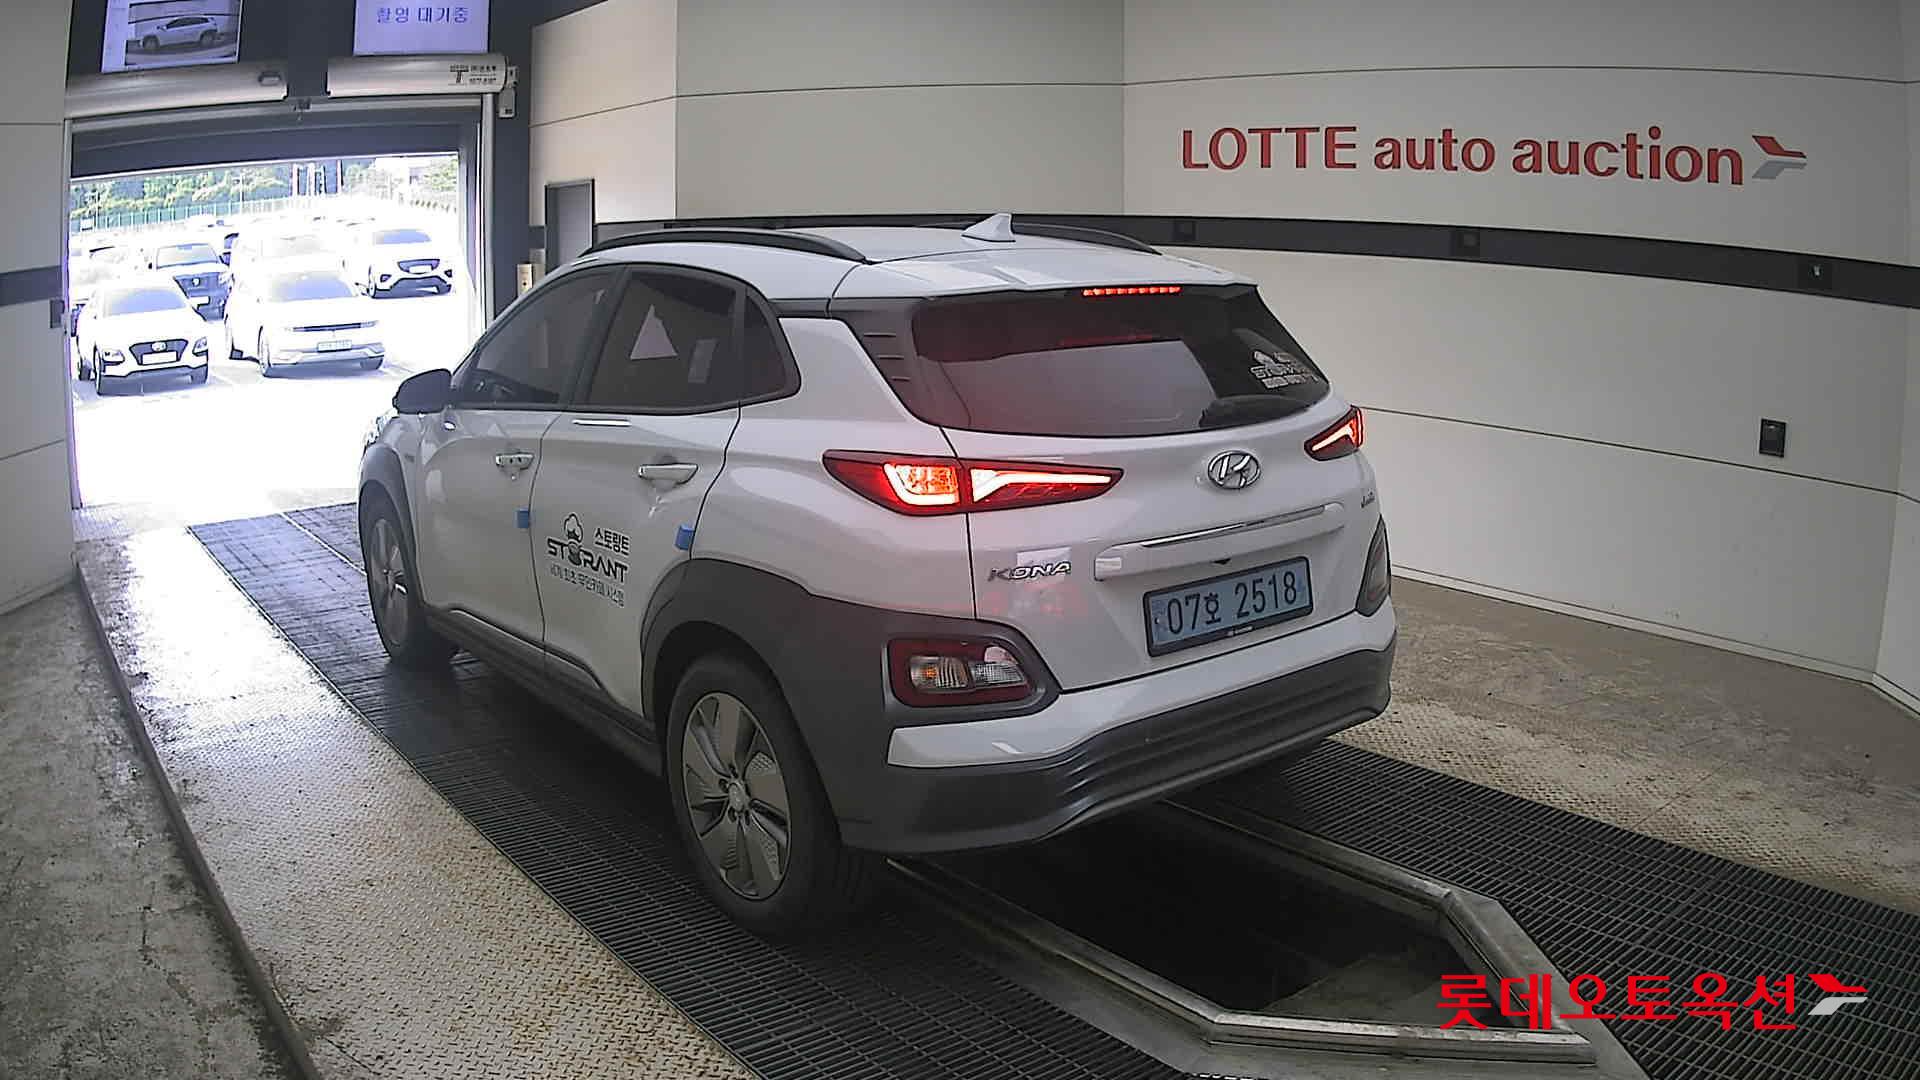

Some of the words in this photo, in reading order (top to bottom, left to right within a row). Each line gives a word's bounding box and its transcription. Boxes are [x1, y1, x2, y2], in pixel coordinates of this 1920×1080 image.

[417, 7, 470, 24] 대기중
[1181, 125, 1358, 170] LOTTE
[1373, 127, 1496, 173] auto
[1512, 125, 1744, 186] auction
[987, 561, 1072, 582] KONA
[1167, 592, 1221, 635] 07호
[1234, 571, 1297, 618] 2518
